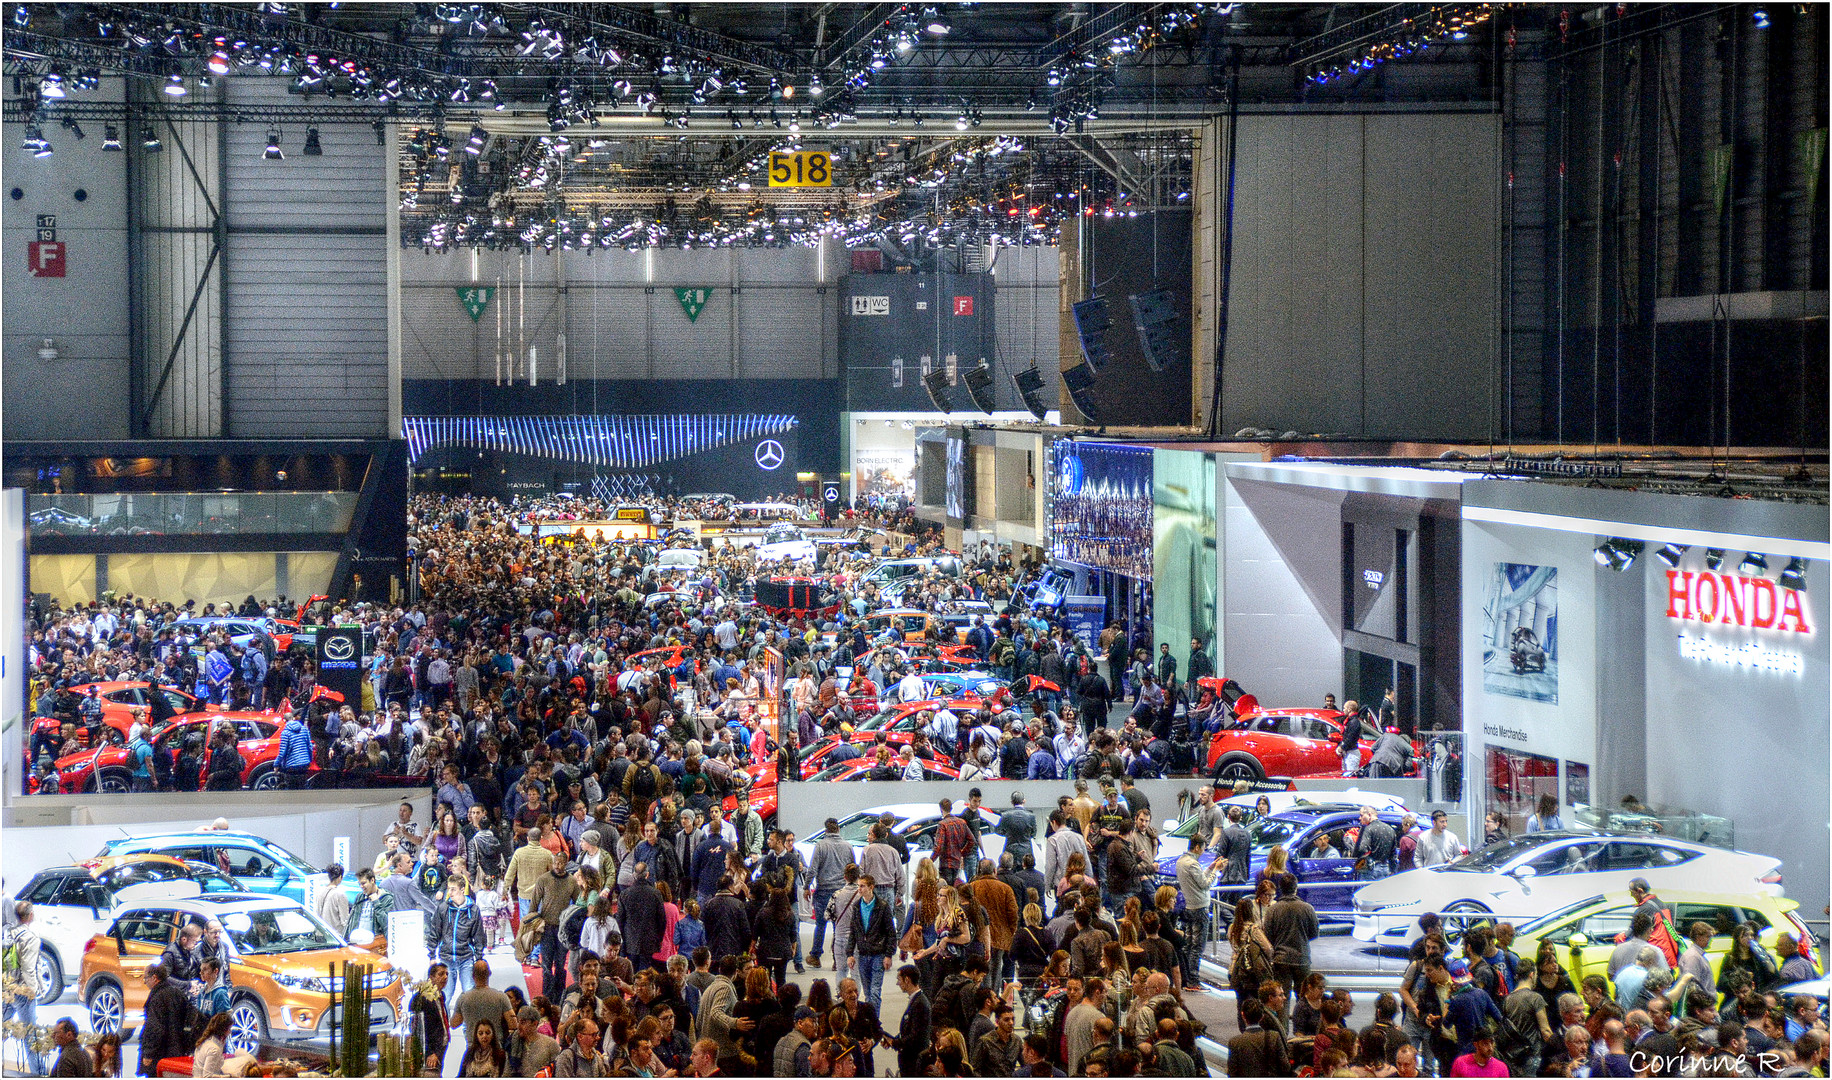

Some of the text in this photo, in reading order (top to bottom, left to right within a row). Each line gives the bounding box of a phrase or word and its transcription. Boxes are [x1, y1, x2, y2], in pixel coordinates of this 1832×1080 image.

[772, 154, 827, 183] 518
[40, 230, 52, 240] 19
[39, 244, 58, 269] F
[872, 299, 888, 307] WC
[960, 300, 968, 312] F
[1665, 570, 1810, 633] HONDA
[1483, 722, 1528, 742] Honda Merchandise
[1216, 777, 1234, 786] Honda
[1254, 781, 1288, 790] Accessories
